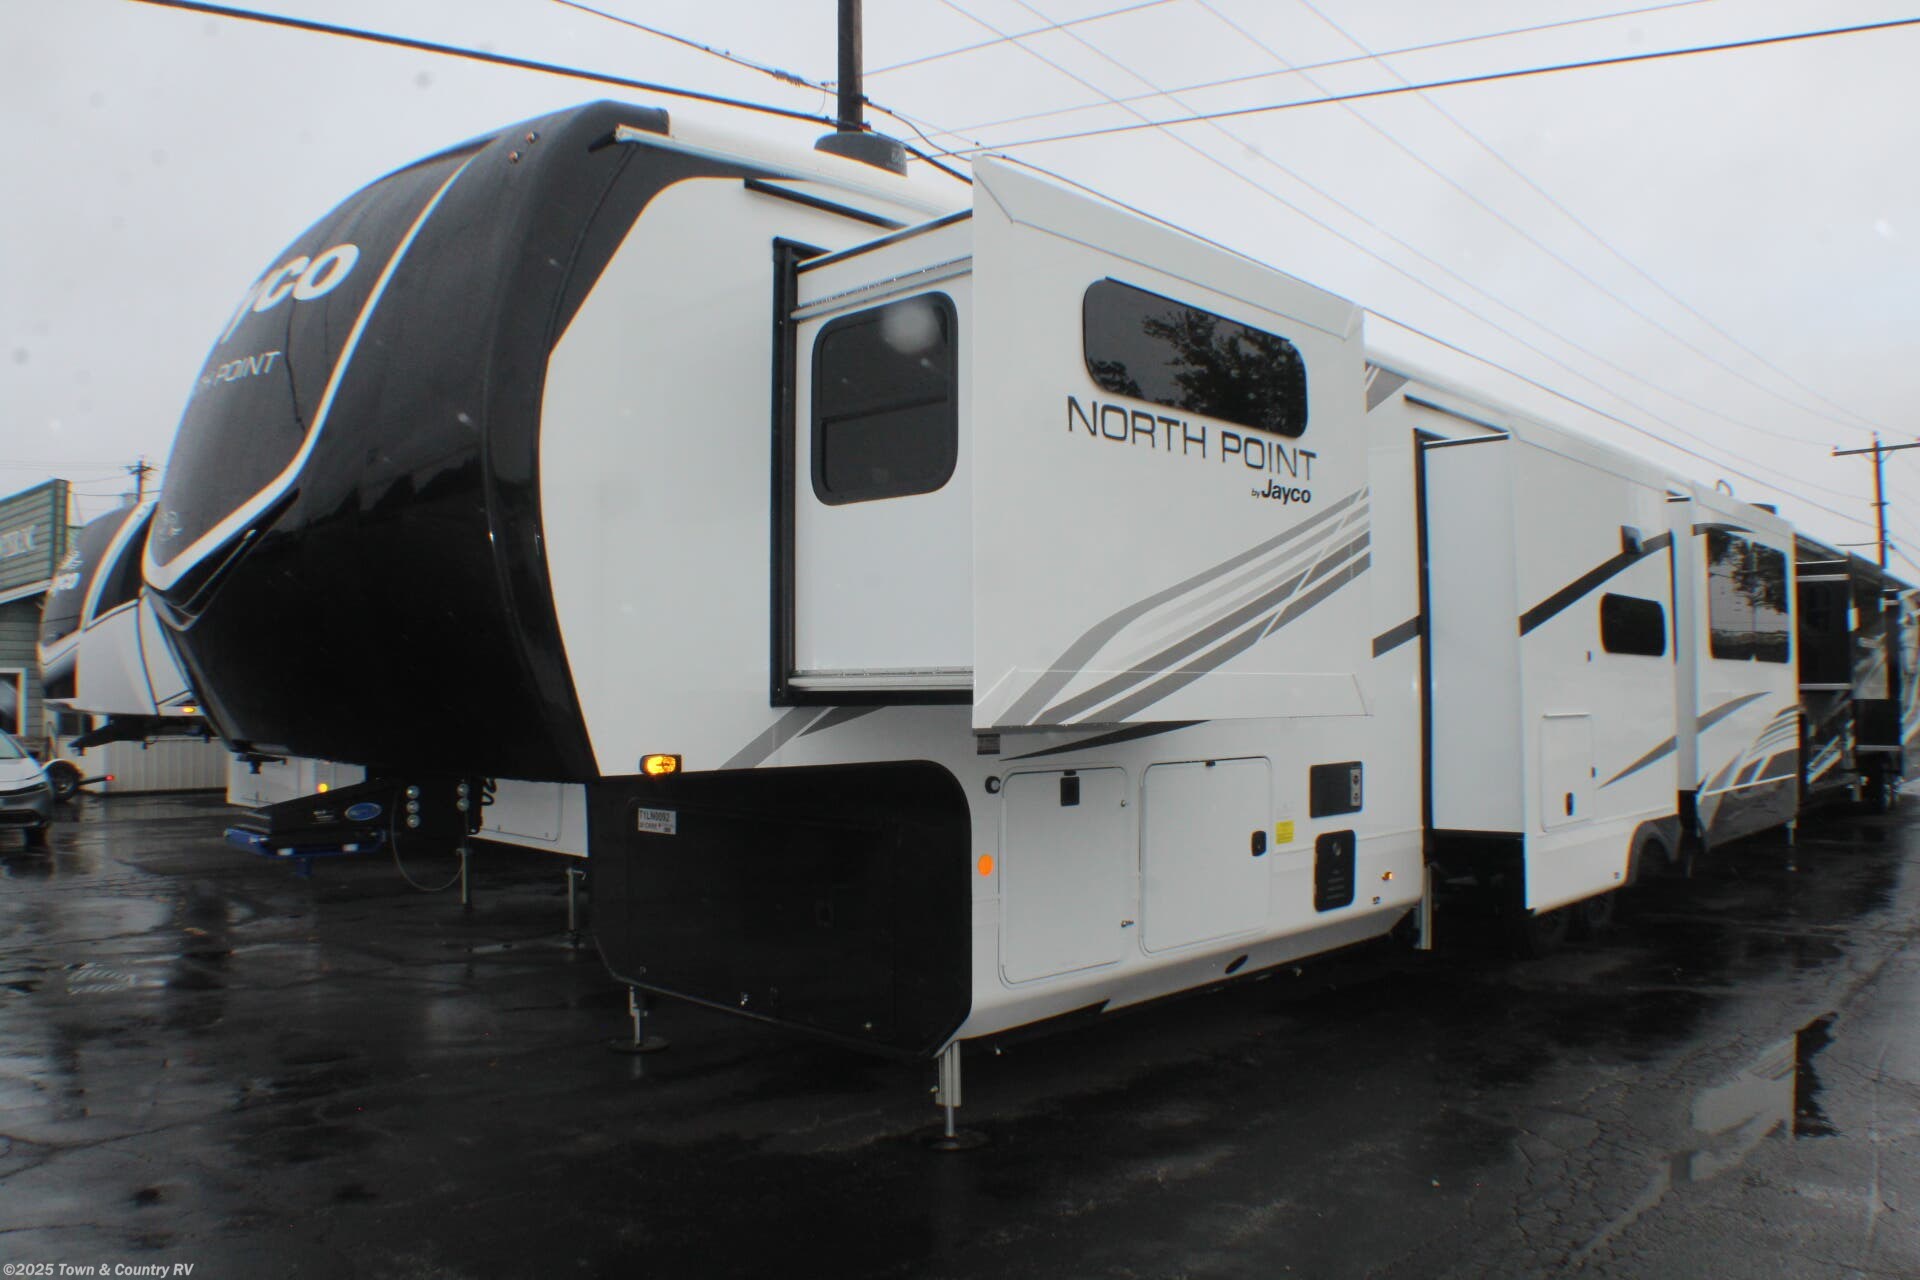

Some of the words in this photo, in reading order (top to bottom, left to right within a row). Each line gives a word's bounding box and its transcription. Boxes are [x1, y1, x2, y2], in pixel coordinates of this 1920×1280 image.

[1067, 395, 1207, 460] NORTH
[1221, 430, 1317, 481] POINT
[1251, 488, 1261, 499] by
[1261, 478, 1312, 505] Jayco
